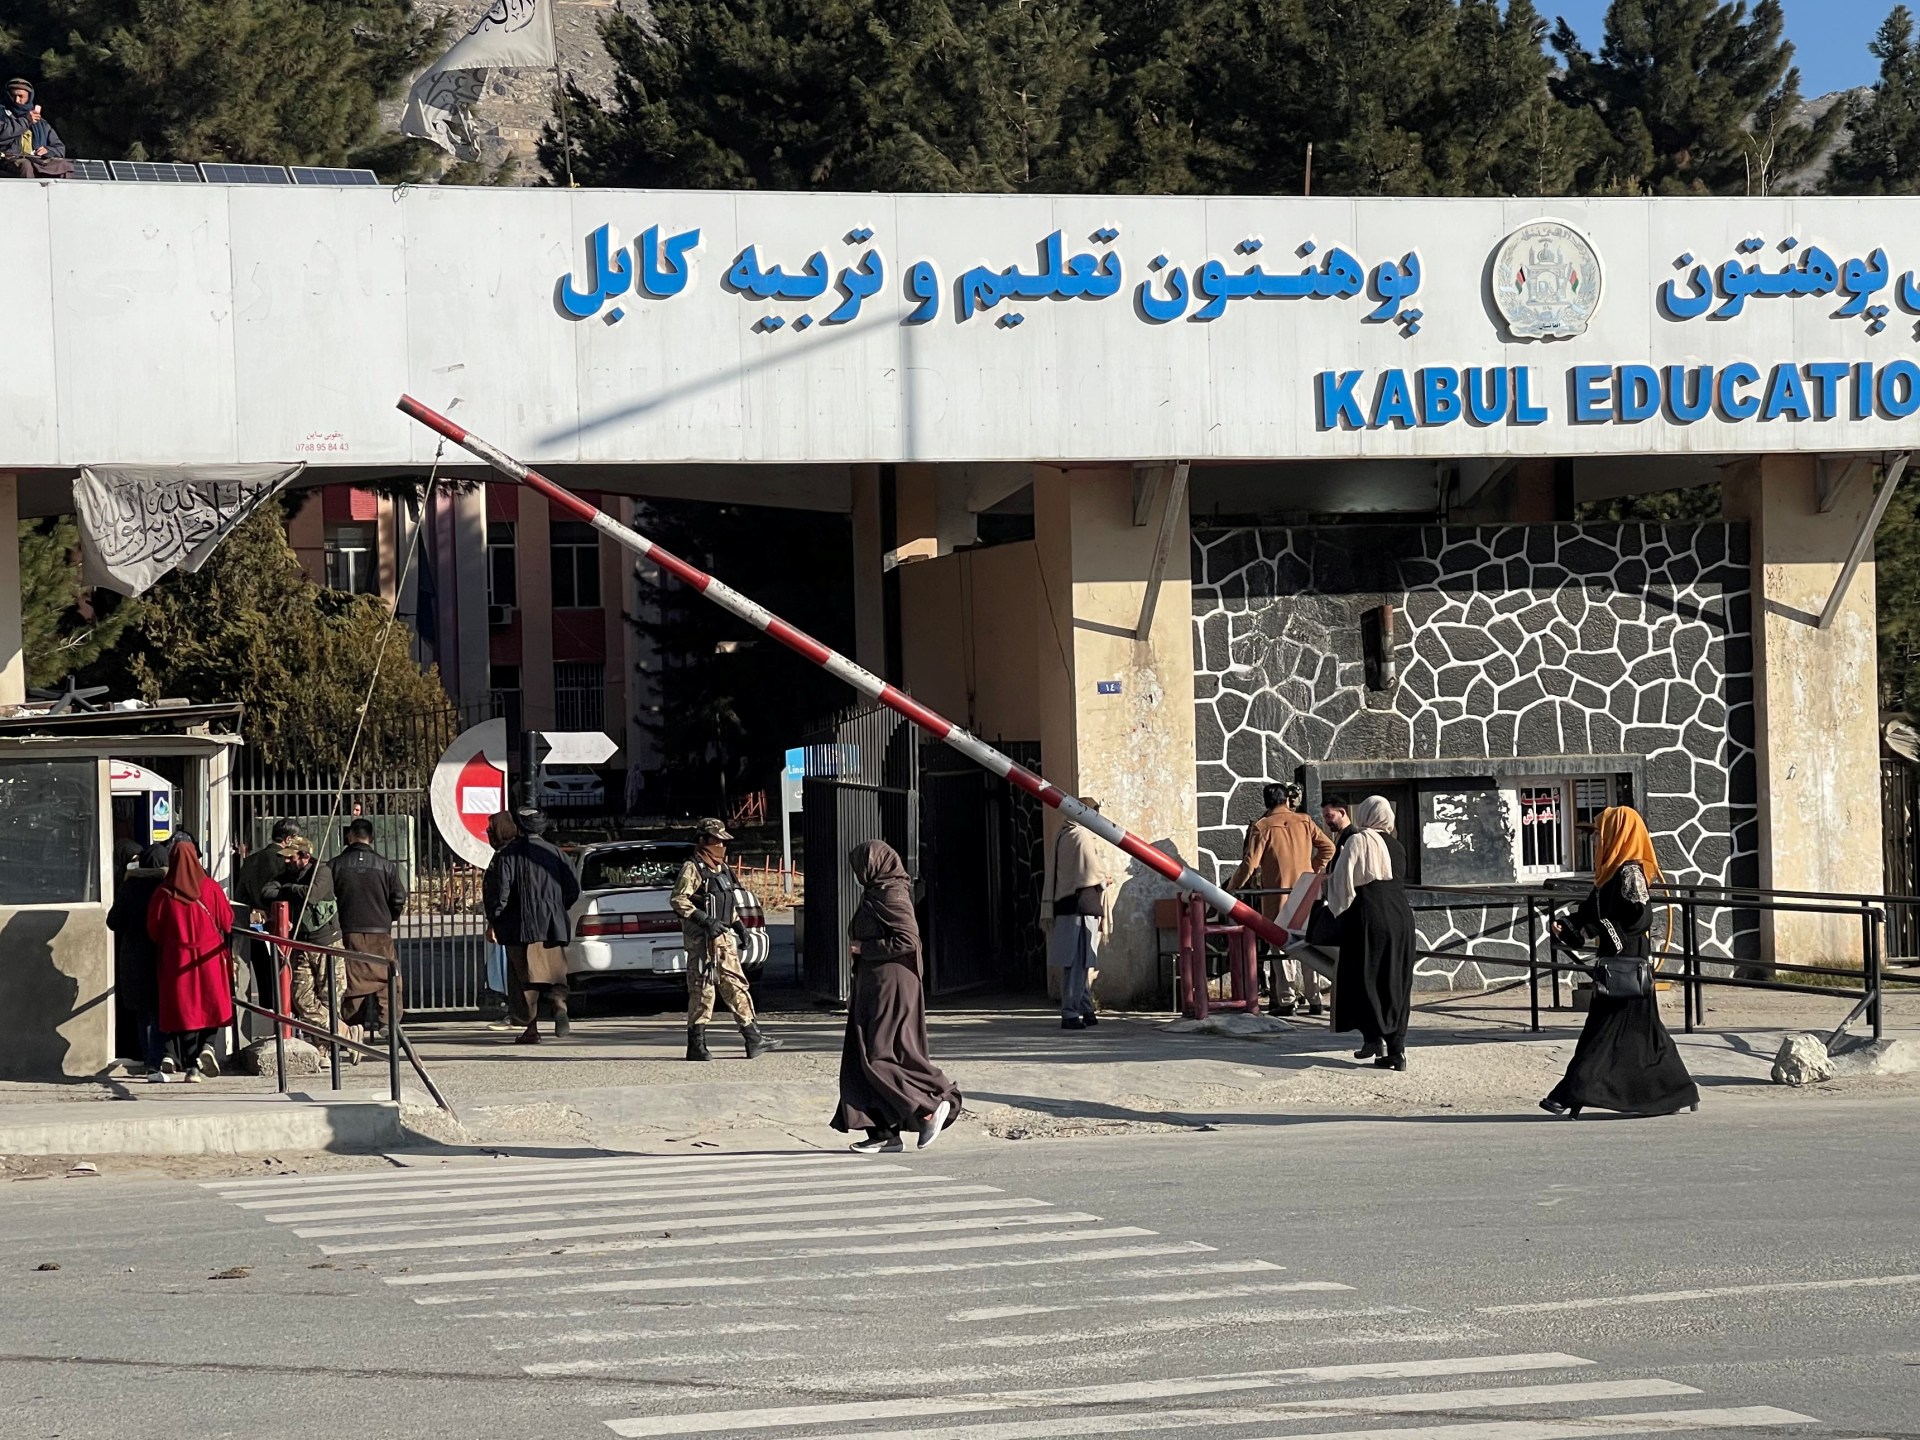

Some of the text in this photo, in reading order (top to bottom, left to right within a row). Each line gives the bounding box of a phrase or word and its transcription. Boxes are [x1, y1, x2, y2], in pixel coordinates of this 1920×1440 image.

[560, 223, 1424, 335] پوهنتون تعلیم و تربیه کابل
[1665, 237, 1889, 332] پوهنتون
[1321, 361, 1920, 428] KABUL EDUCATIO
[316, 443, 326, 451] 95
[328, 443, 337, 451] 84
[339, 443, 349, 451] 43
[110, 766, 142, 780] دخ
